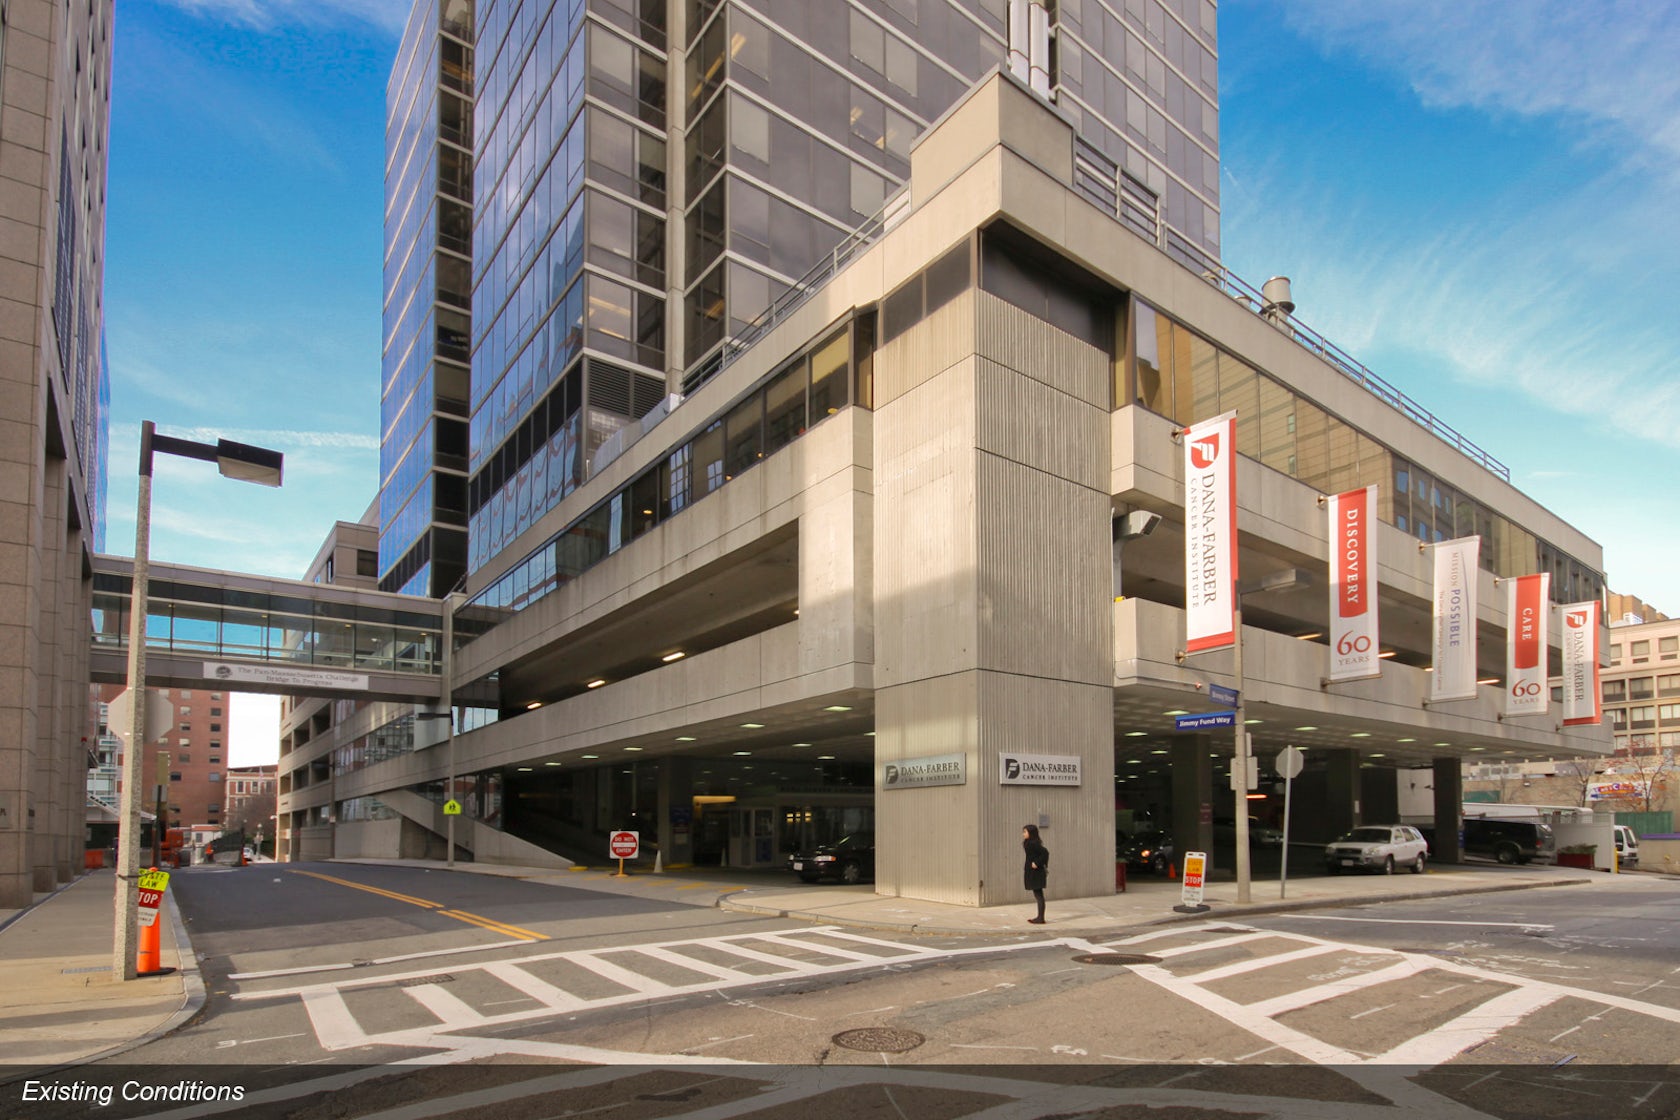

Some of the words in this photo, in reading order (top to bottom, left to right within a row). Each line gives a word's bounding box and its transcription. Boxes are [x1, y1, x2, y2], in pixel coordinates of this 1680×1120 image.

[1190, 478, 1198, 530] CANCER
[1201, 472, 1217, 607] DANA-FARBER
[1346, 508, 1359, 604] DISCOVERY
[1191, 536, 1200, 608] INSTITUTE
[1451, 552, 1459, 586] MISSION
[1449, 589, 1461, 647] POSSIBLE
[1522, 607, 1532, 640] CARE
[1336, 630, 1371, 655] 60
[1337, 655, 1371, 666] YEARS
[1574, 631, 1584, 702] DANA-FARBER
[1512, 679, 1541, 697] 60
[1512, 697, 1540, 705] YEARS
[1179, 720, 1199, 728] Jimmy
[1199, 717, 1215, 725] Fund
[1215, 716, 1231, 724] Way
[900, 761, 960, 777] DANA-FARBER
[1022, 762, 1078, 774] DANA-FARBER
[900, 775, 924, 783] CANCER
[140, 878, 158, 888] LAW
[1185, 876, 1202, 884] STOP
[138, 892, 158, 904] TOP
